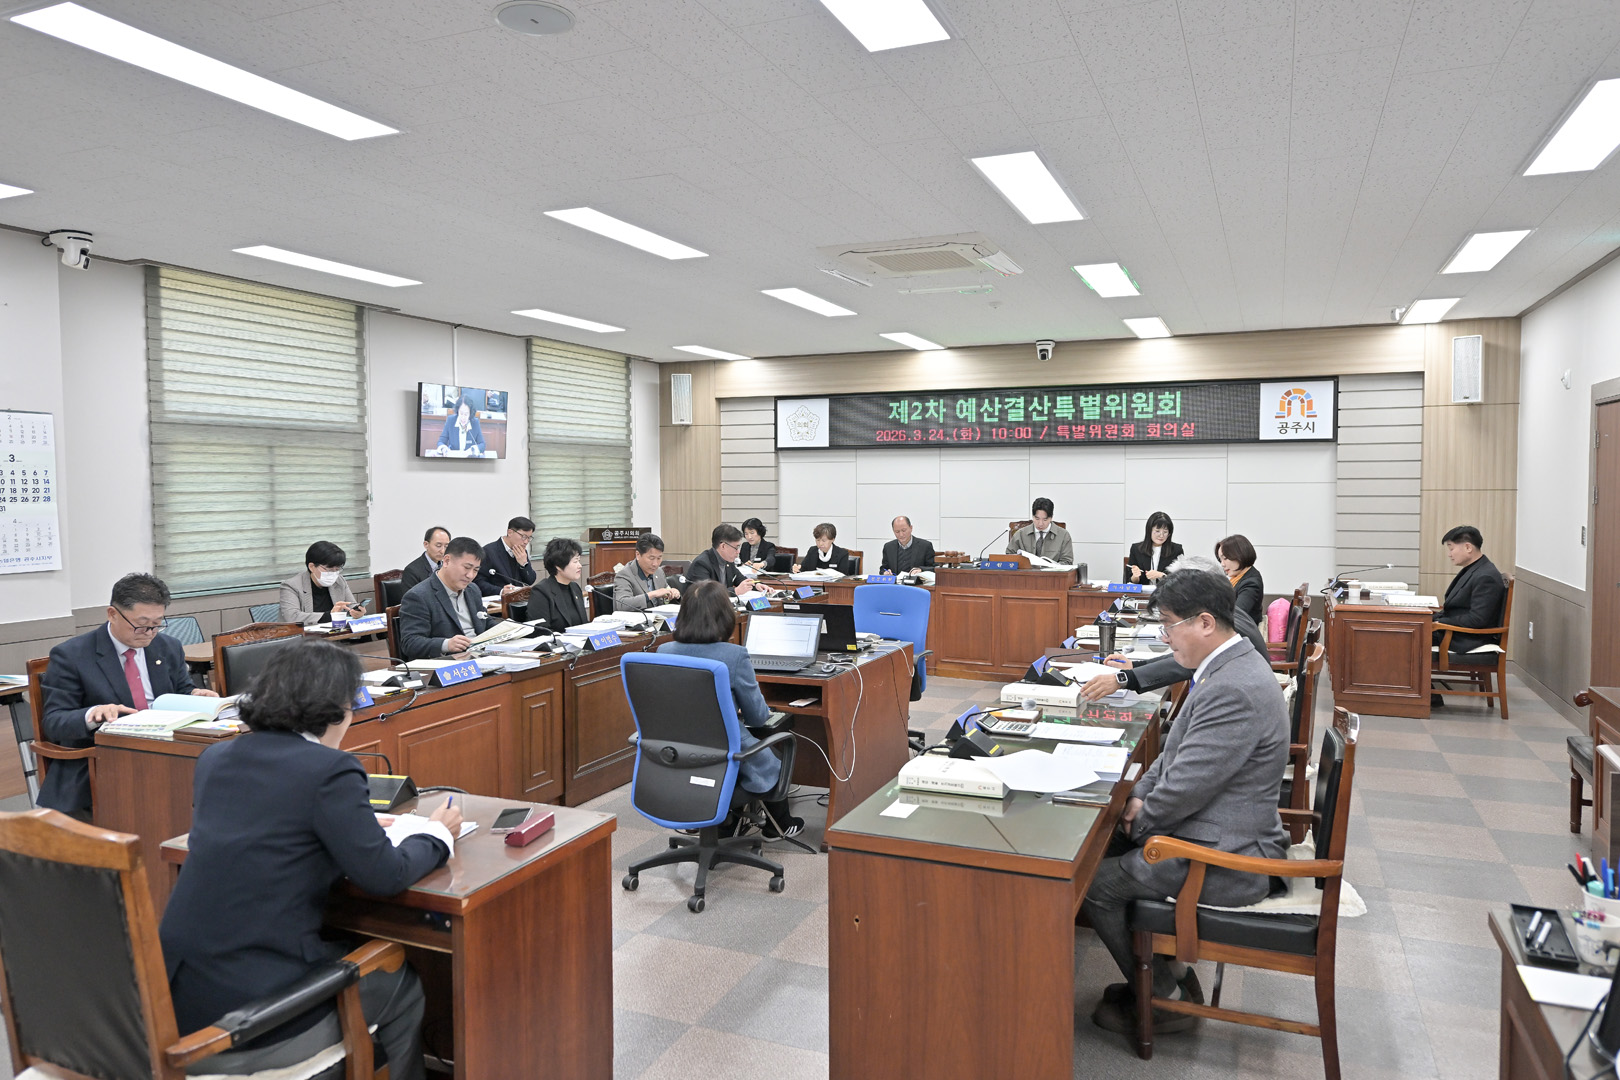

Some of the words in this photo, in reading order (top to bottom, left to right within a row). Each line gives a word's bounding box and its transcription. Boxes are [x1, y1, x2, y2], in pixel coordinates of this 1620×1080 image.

[888, 399, 947, 424] 제2차
[955, 391, 1182, 423] 예산결산특별위원회
[876, 427, 982, 442] 2026.3.24.(화)
[991, 426, 1032, 440] 10:00
[1039, 426, 1048, 440] /
[1056, 423, 1135, 439] 특별위원회
[1146, 422, 1195, 438] 회의실
[1277, 421, 1315, 435] 공주시
[8, 453, 15, 463] 3
[453, 664, 478, 679] 서승열
